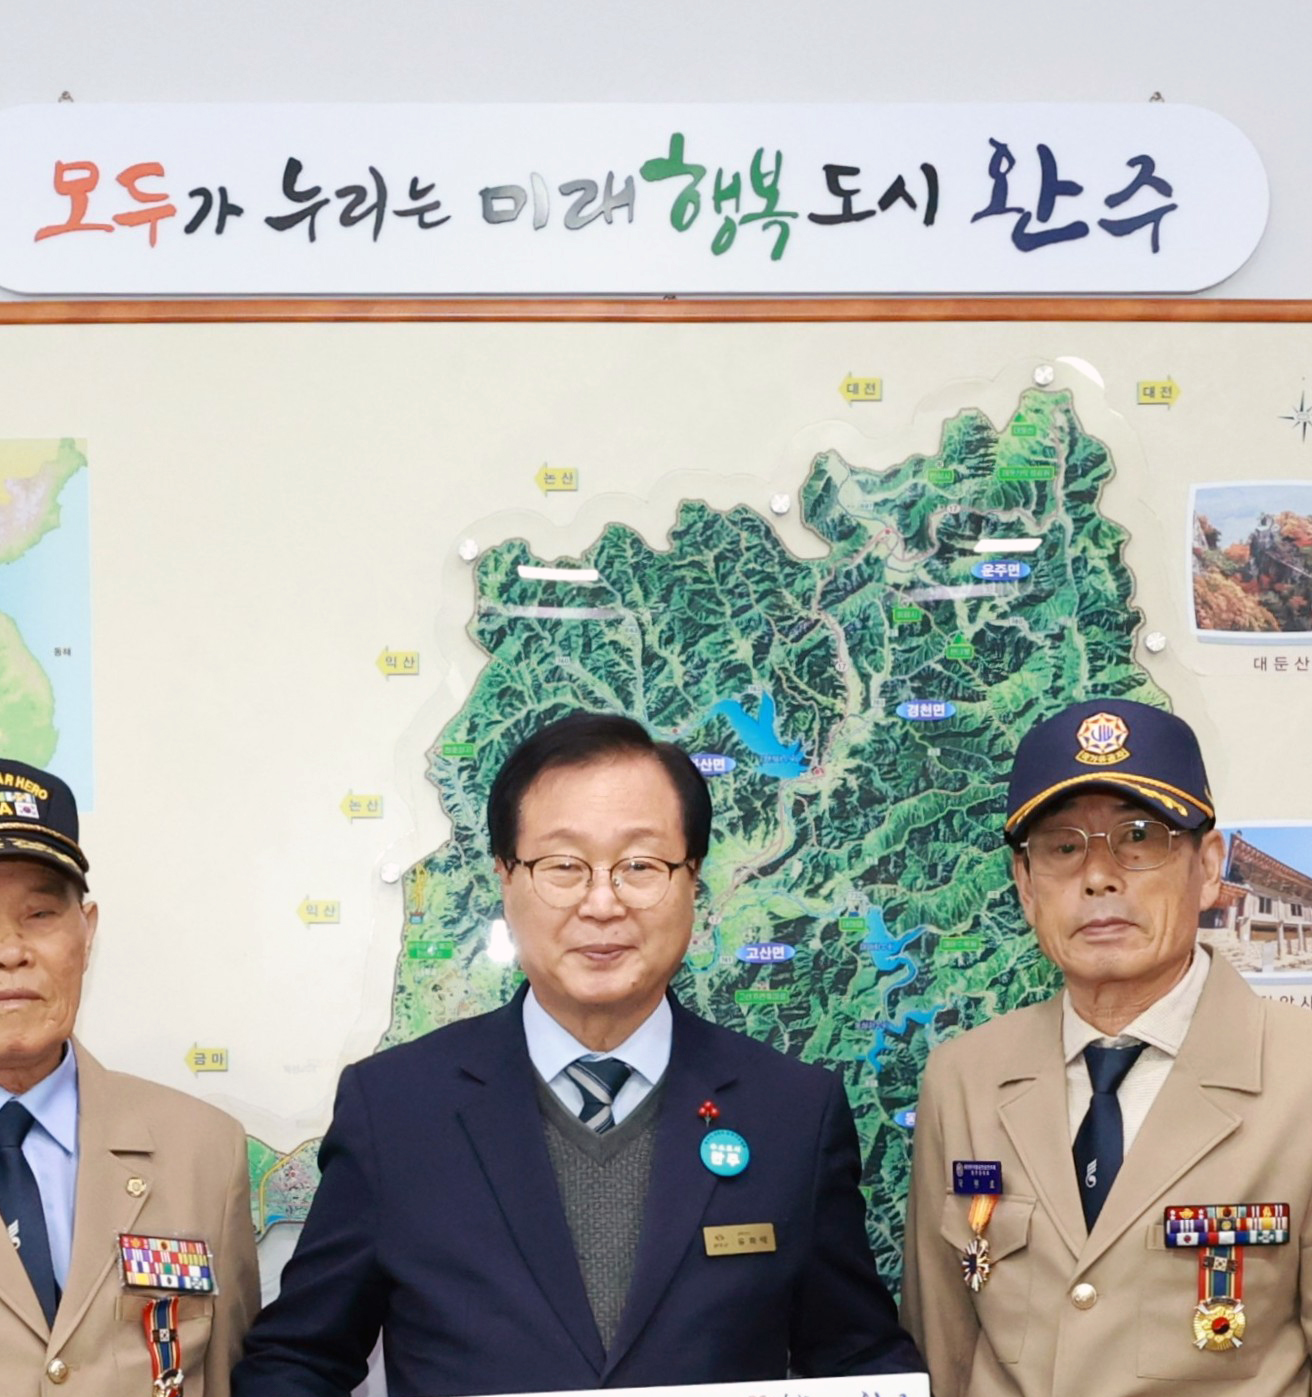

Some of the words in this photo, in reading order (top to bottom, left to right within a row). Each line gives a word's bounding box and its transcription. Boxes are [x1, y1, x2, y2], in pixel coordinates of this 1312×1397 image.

[34, 161, 244, 248] 모두가
[264, 157, 451, 243] 누리는
[970, 137, 1177, 254] 완주
[980, 561, 1022, 578] 운주면
[1254, 656, 1310, 671] 대둔산
[906, 703, 947, 719] 경천면
[14, 776, 48, 801] HERO
[744, 945, 787, 962] 고산면
